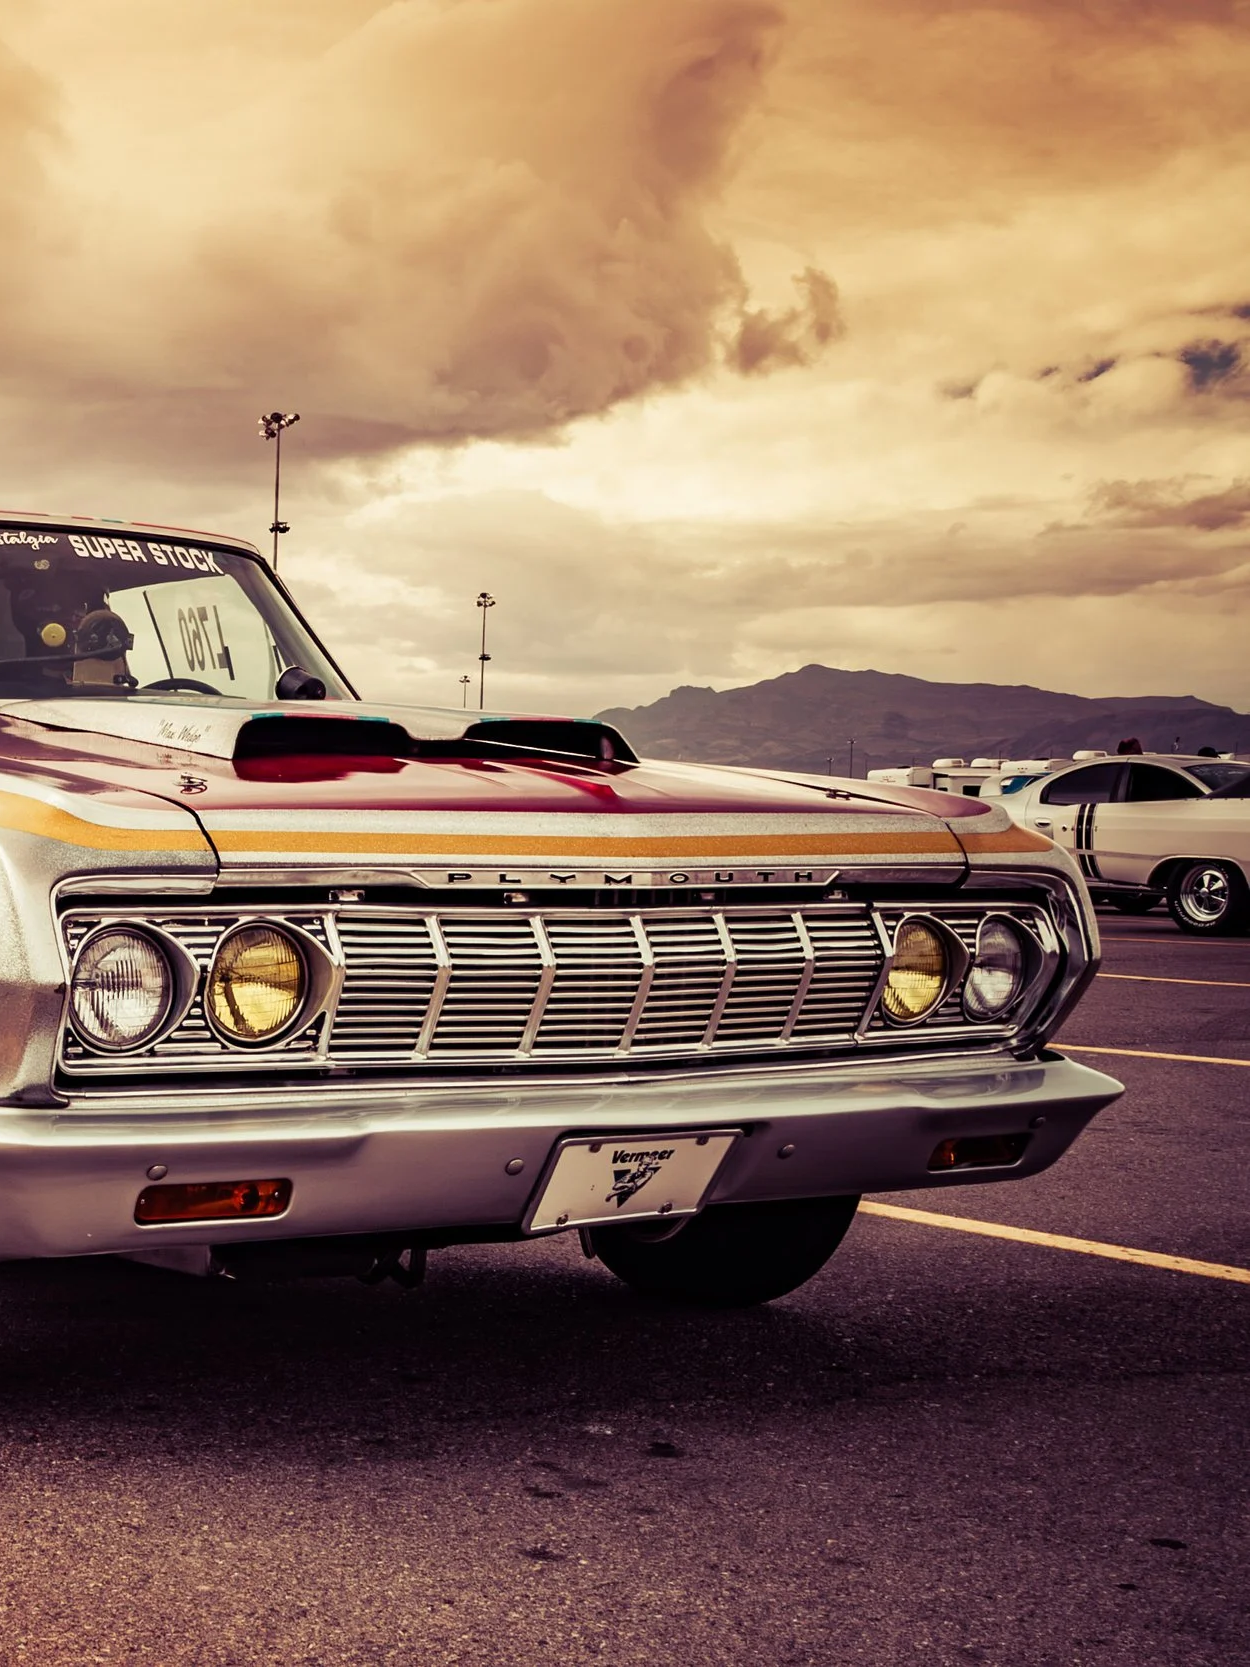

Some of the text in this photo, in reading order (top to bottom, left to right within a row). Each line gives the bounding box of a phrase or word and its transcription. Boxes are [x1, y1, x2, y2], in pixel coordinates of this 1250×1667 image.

[68, 534, 148, 562] SUPER
[147, 542, 224, 574] STOCK
[448, 870, 814, 885] PLYMOUTH
